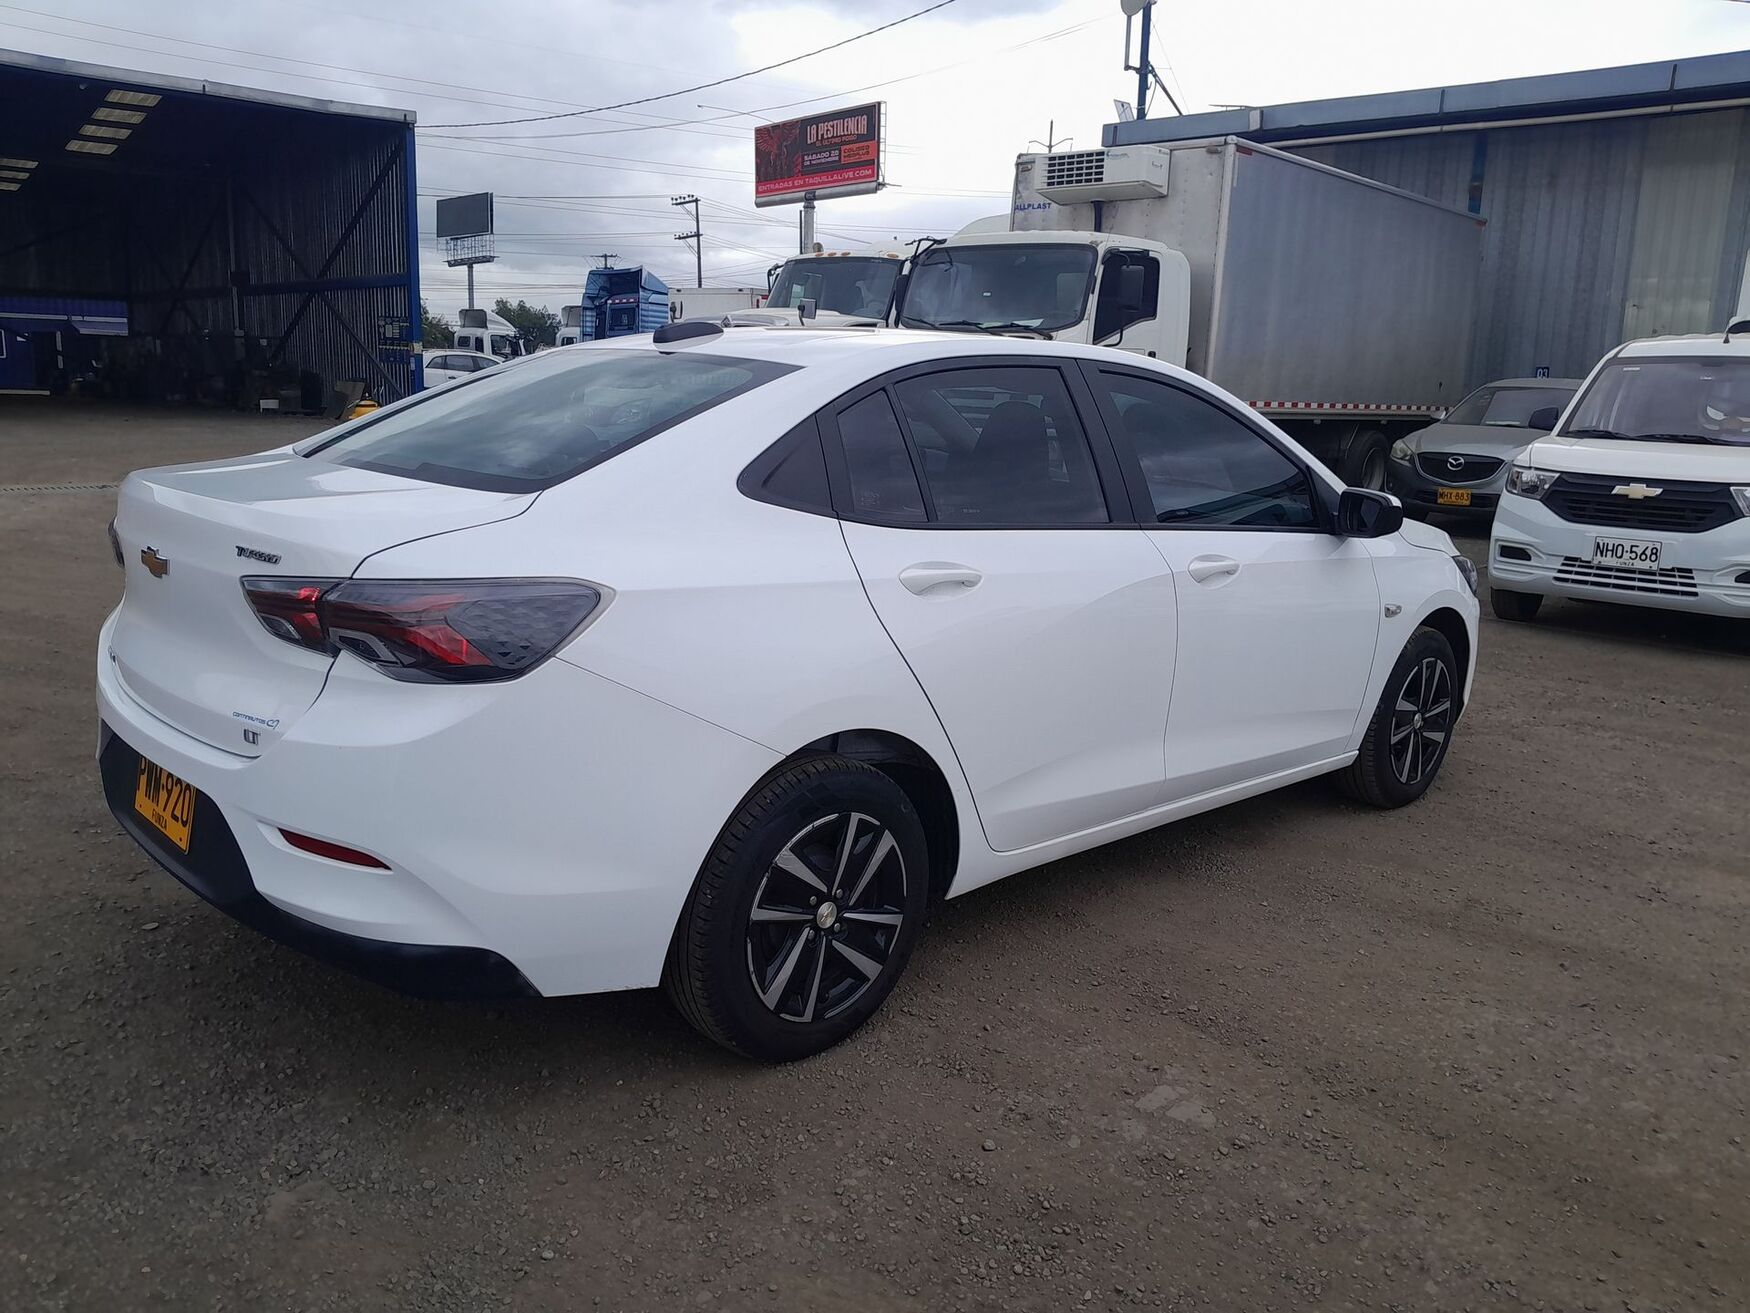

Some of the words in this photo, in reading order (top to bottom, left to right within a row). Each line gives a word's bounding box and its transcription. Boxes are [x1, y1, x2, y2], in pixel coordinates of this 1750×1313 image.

[807, 124, 817, 144] LA
[818, 114, 868, 140] PESTILENCIA
[758, 181, 793, 192] ENTRADAS
[794, 179, 804, 187] EN
